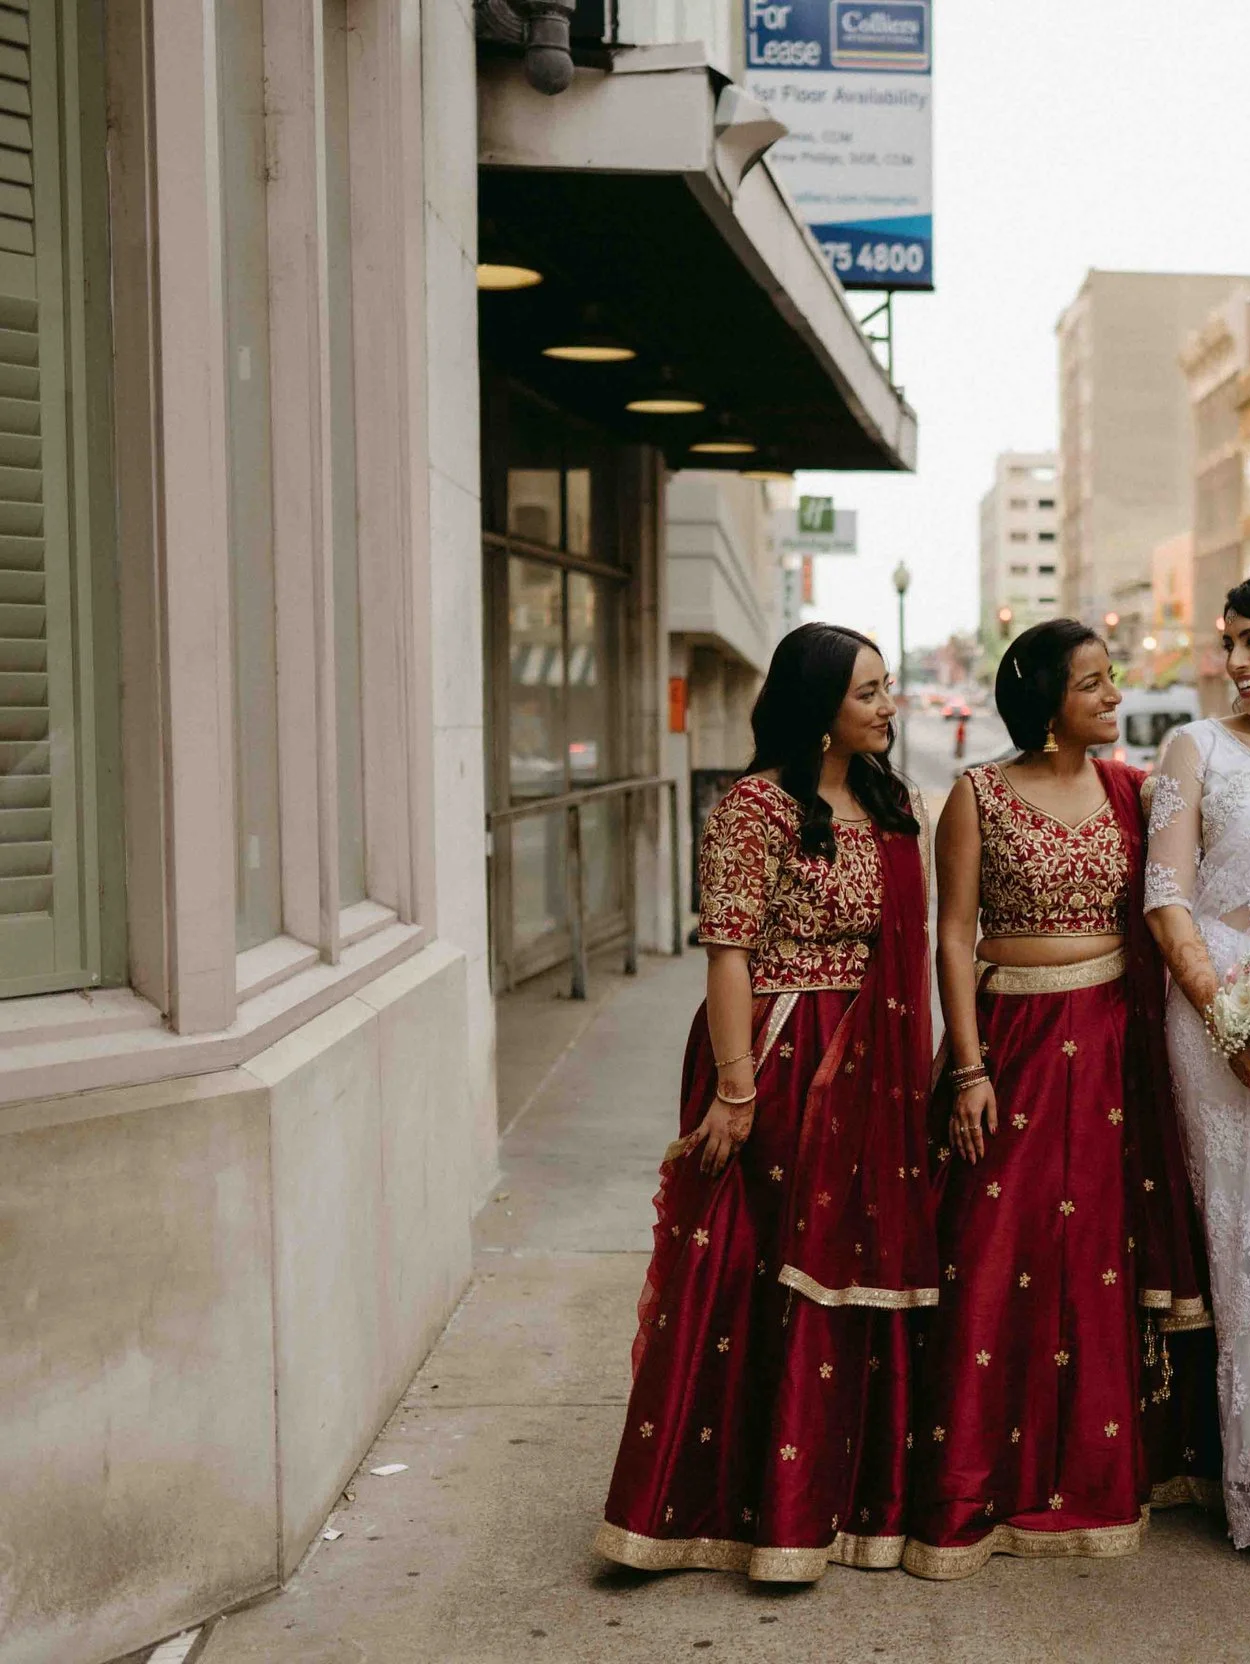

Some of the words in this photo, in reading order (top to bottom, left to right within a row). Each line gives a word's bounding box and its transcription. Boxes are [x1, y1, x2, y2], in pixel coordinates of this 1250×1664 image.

[750, 0, 791, 30] For
[750, 32, 822, 66] Lease
[832, 86, 928, 111] Availability
[857, 242, 924, 273] 4800
